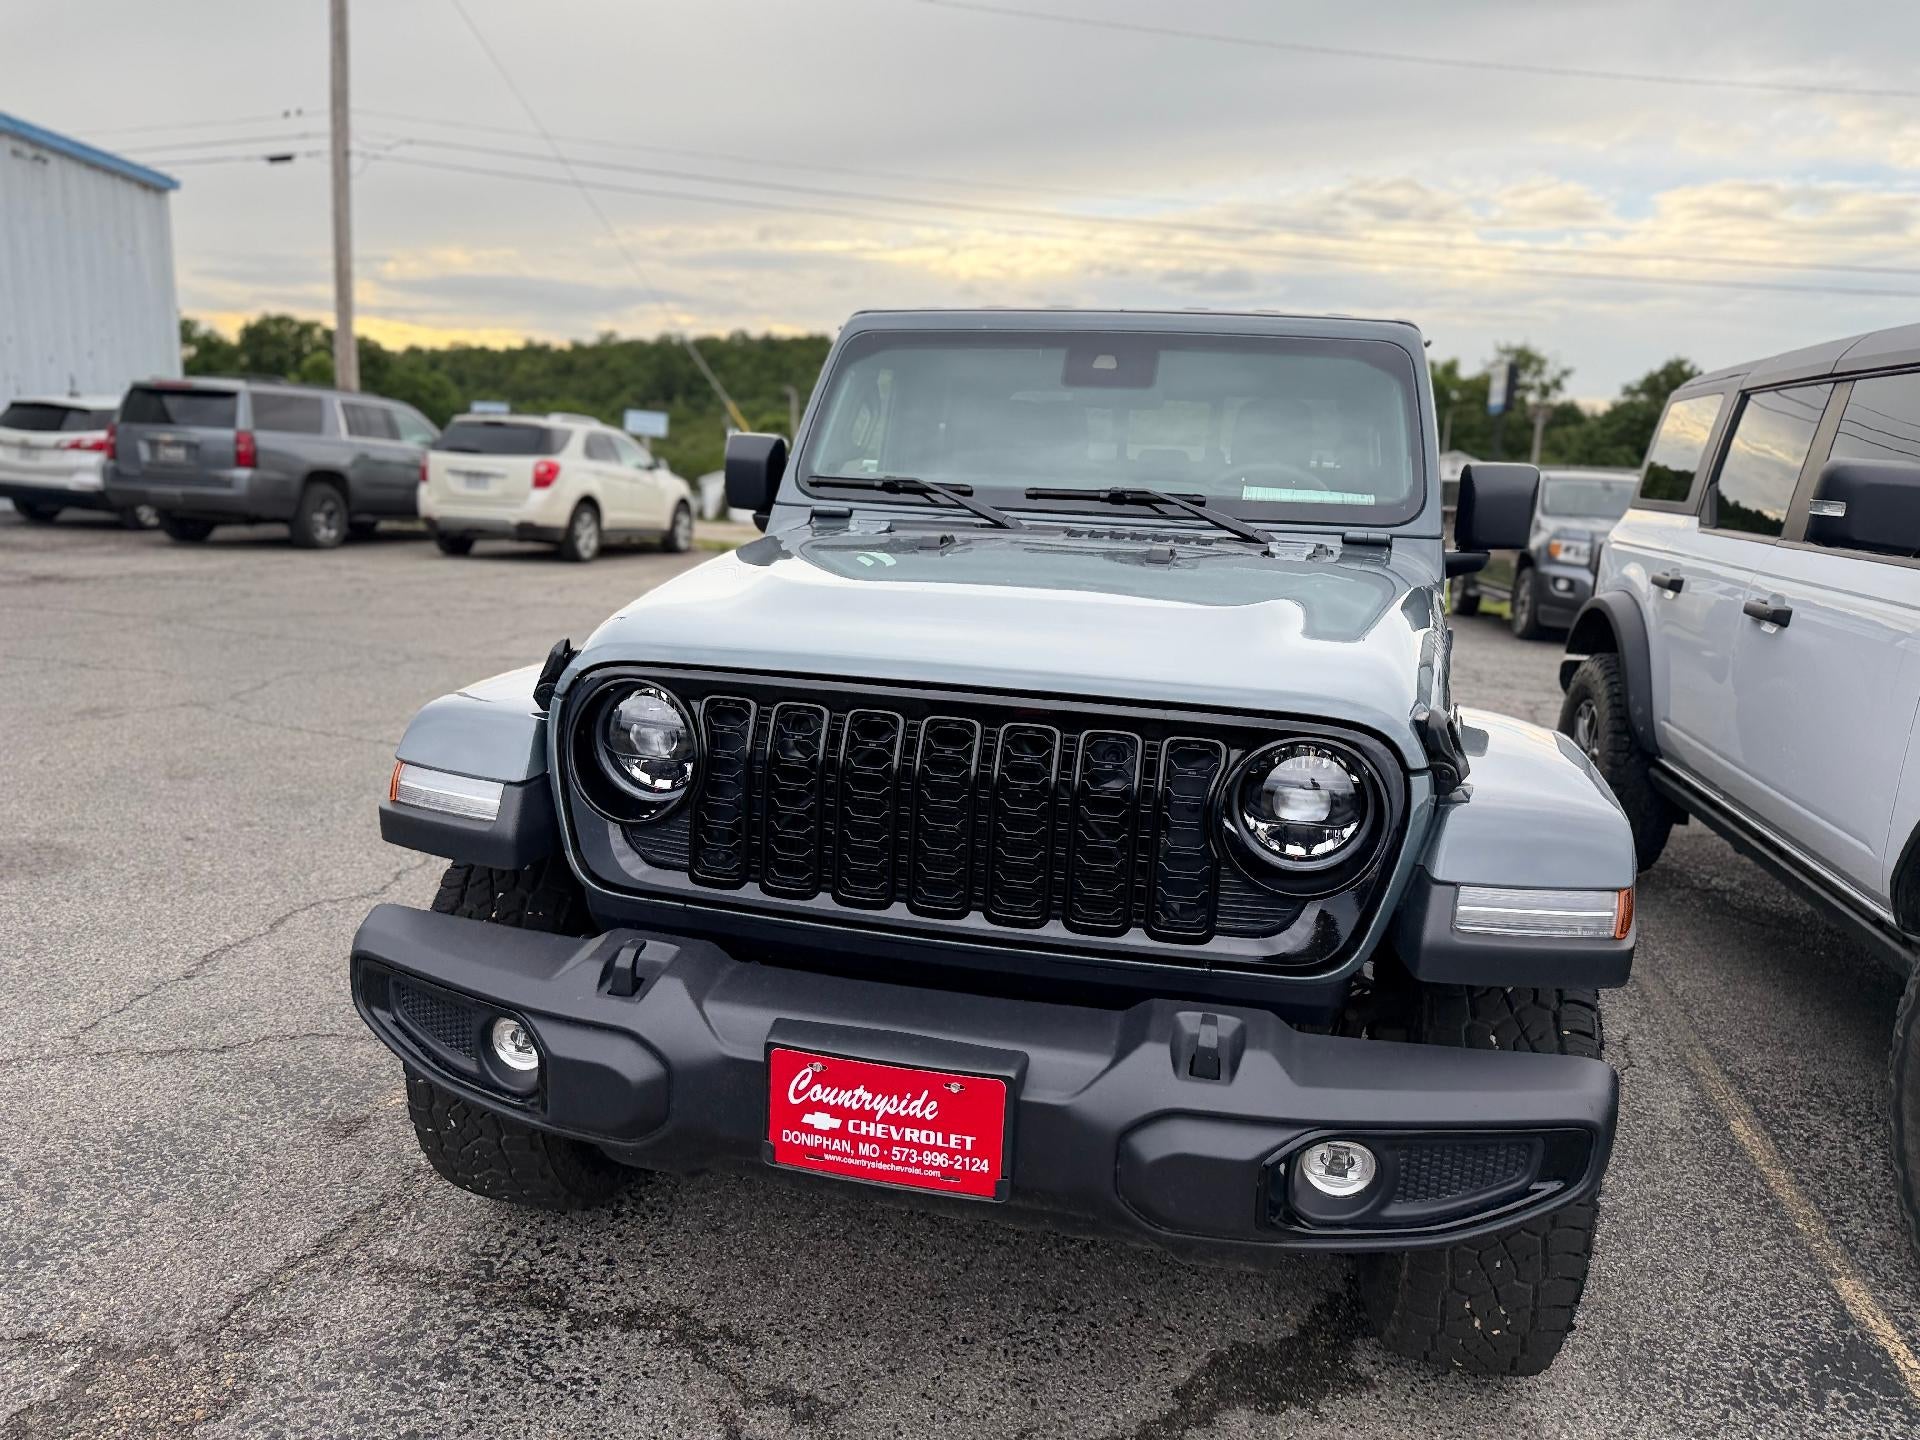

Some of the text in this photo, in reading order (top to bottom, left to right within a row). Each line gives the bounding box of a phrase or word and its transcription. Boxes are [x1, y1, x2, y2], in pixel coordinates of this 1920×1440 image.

[787, 1067, 938, 1121] Countryside
[782, 1129, 990, 1174] DONIPHAN, MO 573-996-2124
[847, 1119, 976, 1151] CHEVROLET
